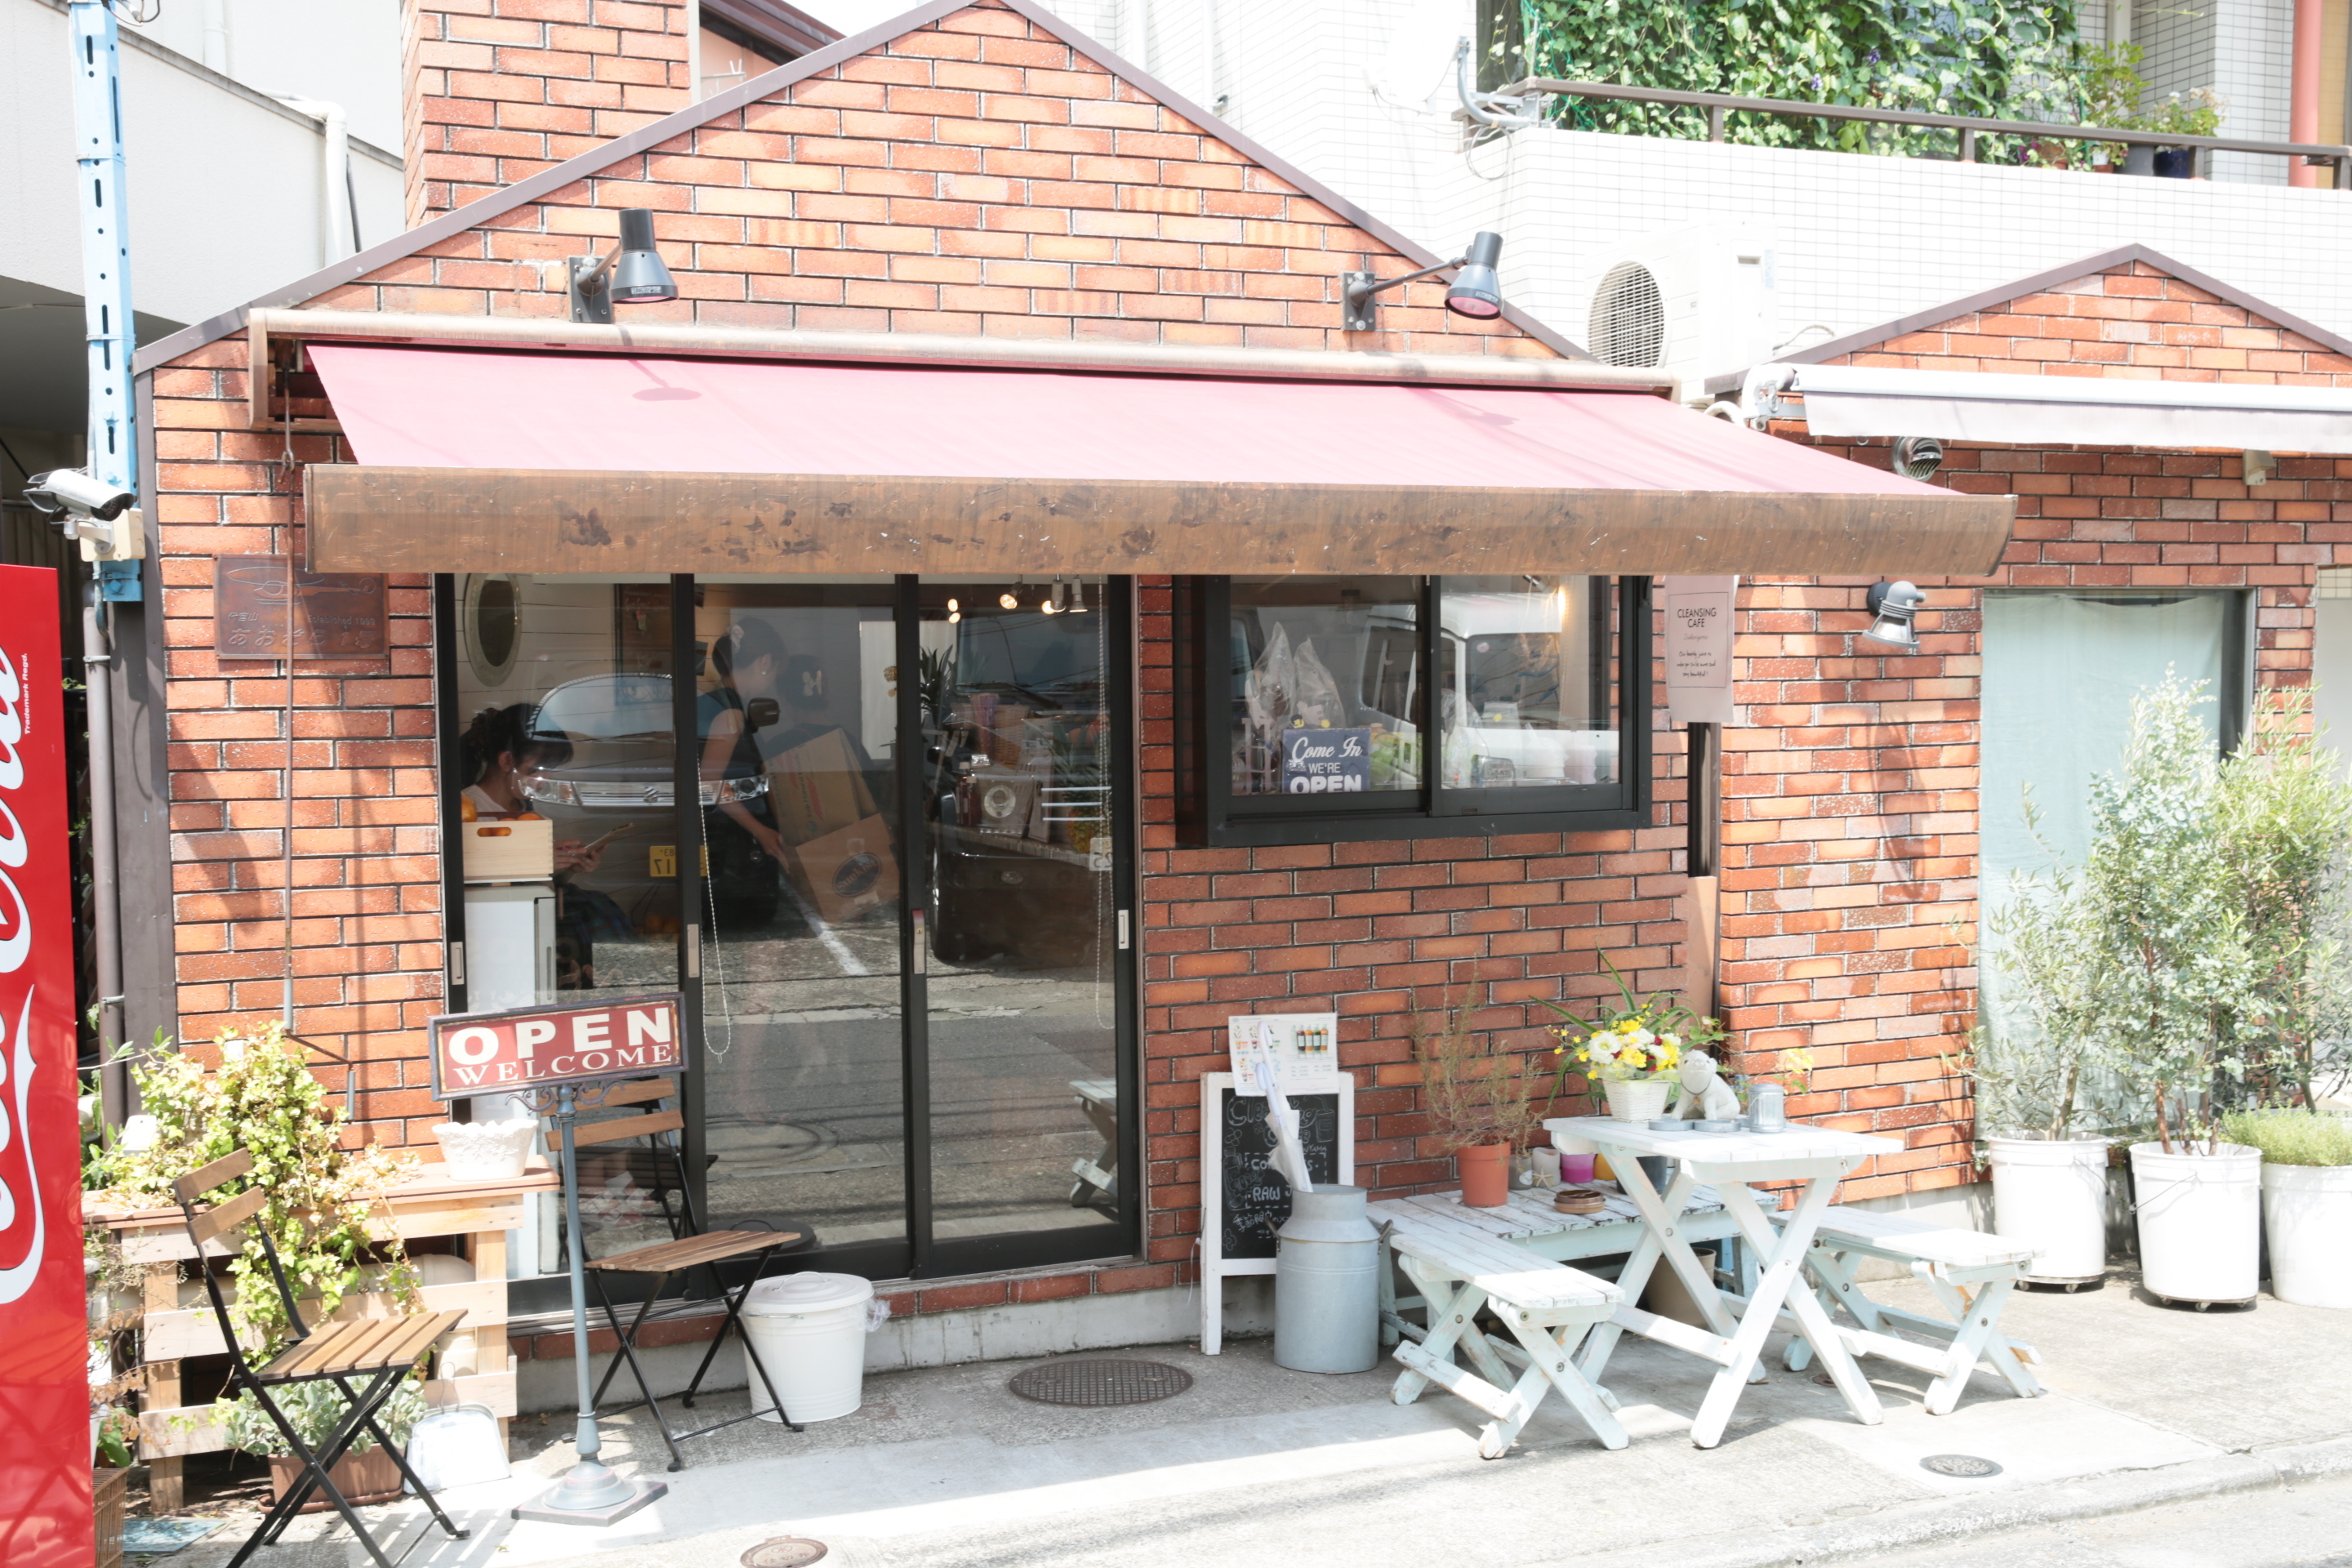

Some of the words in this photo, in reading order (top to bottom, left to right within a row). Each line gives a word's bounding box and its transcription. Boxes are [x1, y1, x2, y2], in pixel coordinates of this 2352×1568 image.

[227, 612, 260, 623] 代官山
[308, 613, 353, 626] Established
[1677, 608, 1717, 618] CLEANSING
[1687, 618, 1705, 628] CAFE
[20, 653, 29, 680] Regd.
[22, 684, 31, 735] Trademark
[1288, 736, 1336, 763] Come
[1338, 736, 1363, 758] In
[1307, 762, 1341, 774] WE'RE
[1290, 774, 1362, 795] OPEN
[835, 857, 878, 889] Sunkist
[448, 1007, 671, 1066] OPEN
[452, 1044, 672, 1086] WELCOME
[1253, 1186, 1281, 1202] RAW
